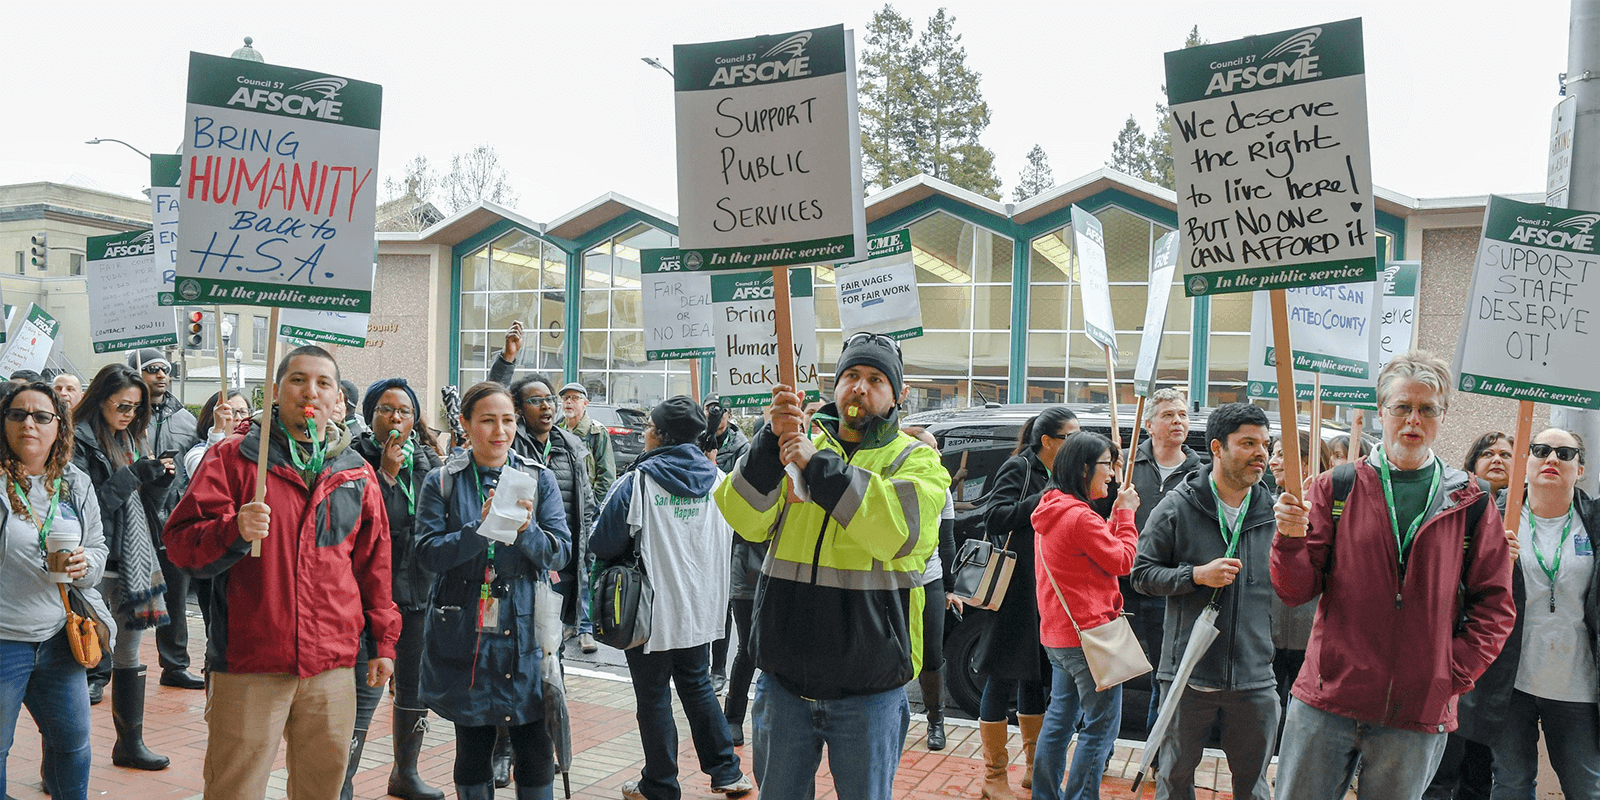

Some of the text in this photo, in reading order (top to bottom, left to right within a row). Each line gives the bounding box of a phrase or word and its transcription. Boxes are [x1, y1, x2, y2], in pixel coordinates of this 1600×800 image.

[715, 53, 757, 64] Council 57
[1210, 55, 1257, 70] Council 57
[236, 76, 285, 90] Council 57
[709, 56, 810, 87] AFSCME
[1204, 55, 1320, 96] AFSCME
[227, 87, 343, 121] AFSCME
[715, 97, 817, 138] SUPPORT
[1173, 100, 1339, 143] We deserve
[194, 117, 300, 160] BRING
[721, 146, 810, 185] PUBLIC
[1191, 149, 1238, 173] the
[188, 155, 373, 223] HUMANITY
[1187, 184, 1212, 208] to
[1224, 178, 1272, 204] live
[713, 197, 823, 233] SERVICES
[1517, 216, 1540, 226] Council
[310, 219, 337, 240] to
[1185, 217, 1231, 246] BUT
[1346, 219, 1369, 247] it
[1509, 226, 1595, 252] AFSCME
[104, 243, 154, 258] AFSCME
[190, 232, 335, 285] H.S.A.
[710, 243, 845, 266] In the public service
[1485, 245, 1598, 283] SUPPORT
[841, 274, 893, 291] FAIR WAGES
[1215, 265, 1365, 289] In the public service
[208, 285, 361, 307] In the public service
[654, 282, 685, 299] FAIR
[842, 285, 911, 305] FOR FAIR WORK
[1338, 285, 1364, 305] SAN
[1494, 275, 1578, 305] STAFF
[677, 312, 691, 321] OR
[1323, 309, 1367, 337] COUNTY
[1480, 296, 1590, 335] DESERVE
[108, 337, 173, 350] In the public service
[304, 330, 316, 338] the
[315, 332, 338, 341] public
[338, 337, 361, 345] service
[654, 326, 674, 341] NO
[680, 350, 701, 358] public
[1506, 331, 1551, 367] OT!
[730, 365, 774, 386] Back
[1296, 356, 1364, 374] the public service
[1298, 388, 1333, 399] pulic
[1333, 390, 1370, 399] service
[1479, 380, 1592, 405] In the public service
[654, 494, 669, 506] San
[674, 507, 700, 520] Happen
